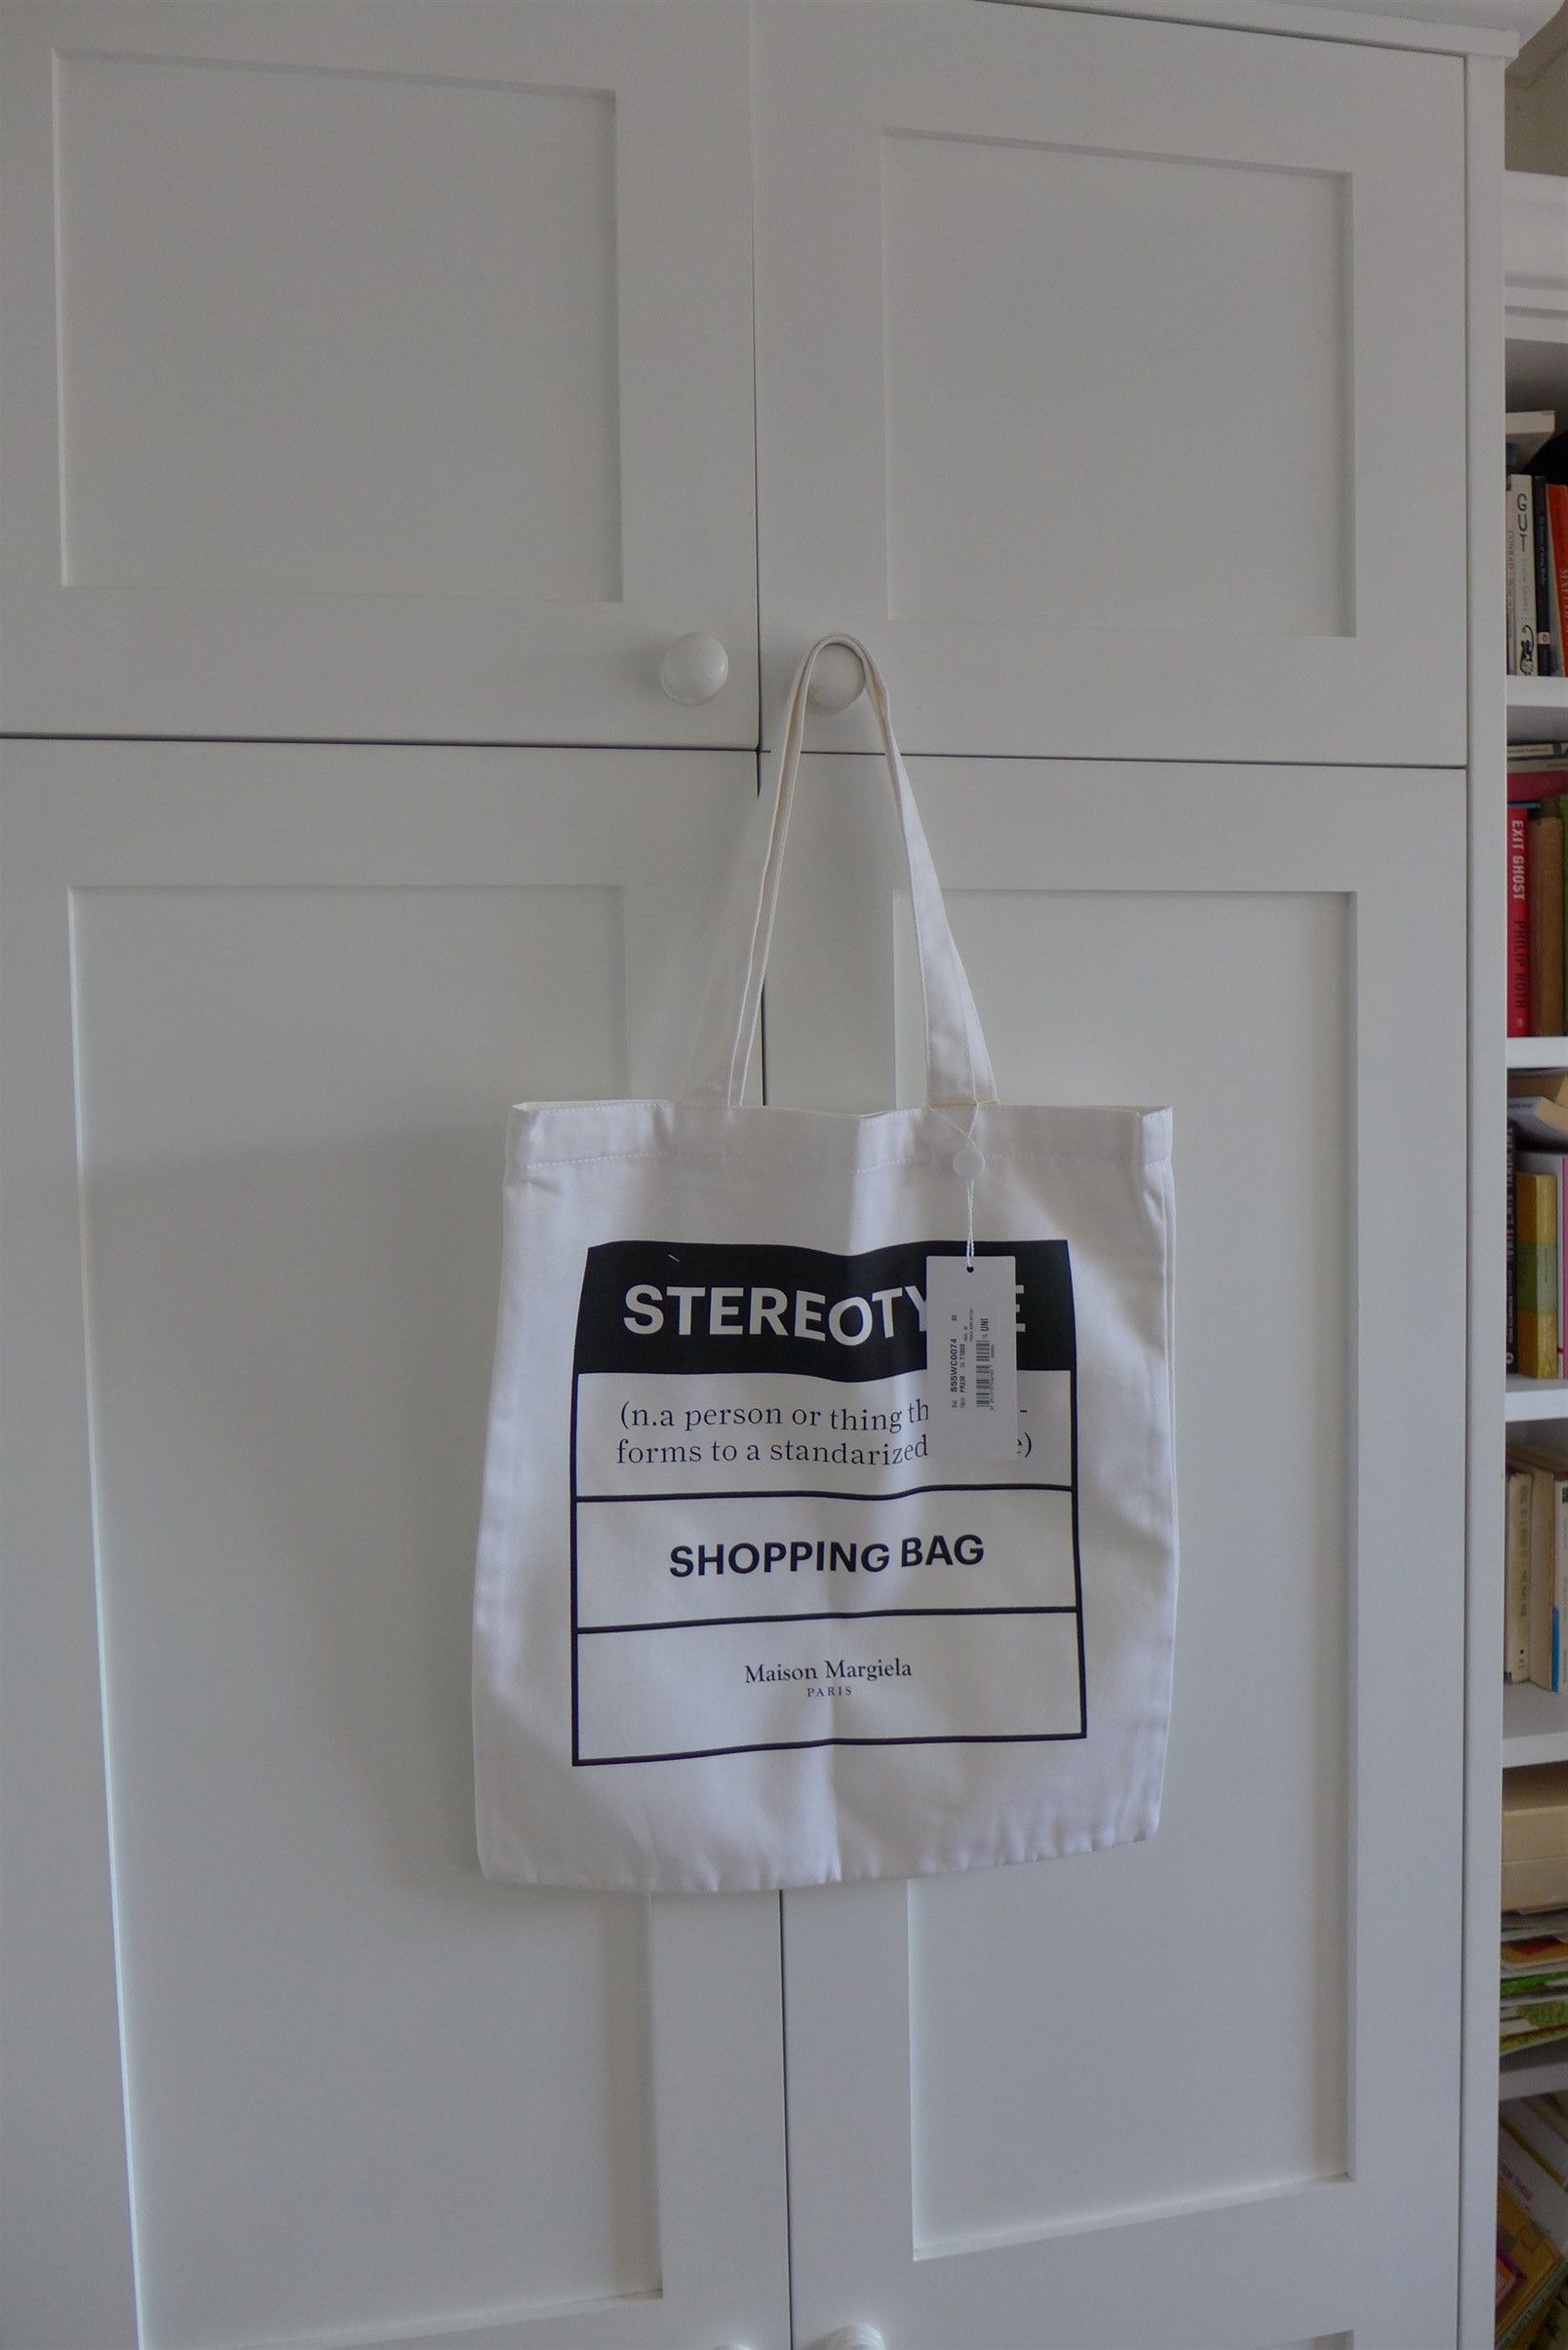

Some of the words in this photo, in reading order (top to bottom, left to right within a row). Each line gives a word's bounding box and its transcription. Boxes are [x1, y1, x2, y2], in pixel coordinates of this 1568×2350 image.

[1516, 492, 1528, 552] GUT
[1512, 820, 1524, 850] EXIT
[1512, 855, 1525, 900] GHOST
[623, 1283, 1026, 1347] STEREOTY
[980, 1317, 989, 1332] UNI
[620, 1401, 675, 1430] (n.a
[685, 1408, 783, 1431] person
[792, 1409, 821, 1427] or
[830, 1408, 903, 1433] thing
[617, 1438, 702, 1464] forms
[711, 1440, 738, 1462] to
[747, 1443, 761, 1461] a
[770, 1433, 928, 1466] standarized
[669, 1541, 890, 1578] SHOPPING
[901, 1534, 985, 1567] BAG
[744, 1663, 818, 1683] Maison
[824, 1658, 913, 1682] Margiela
[806, 1686, 852, 1698] PARIS
